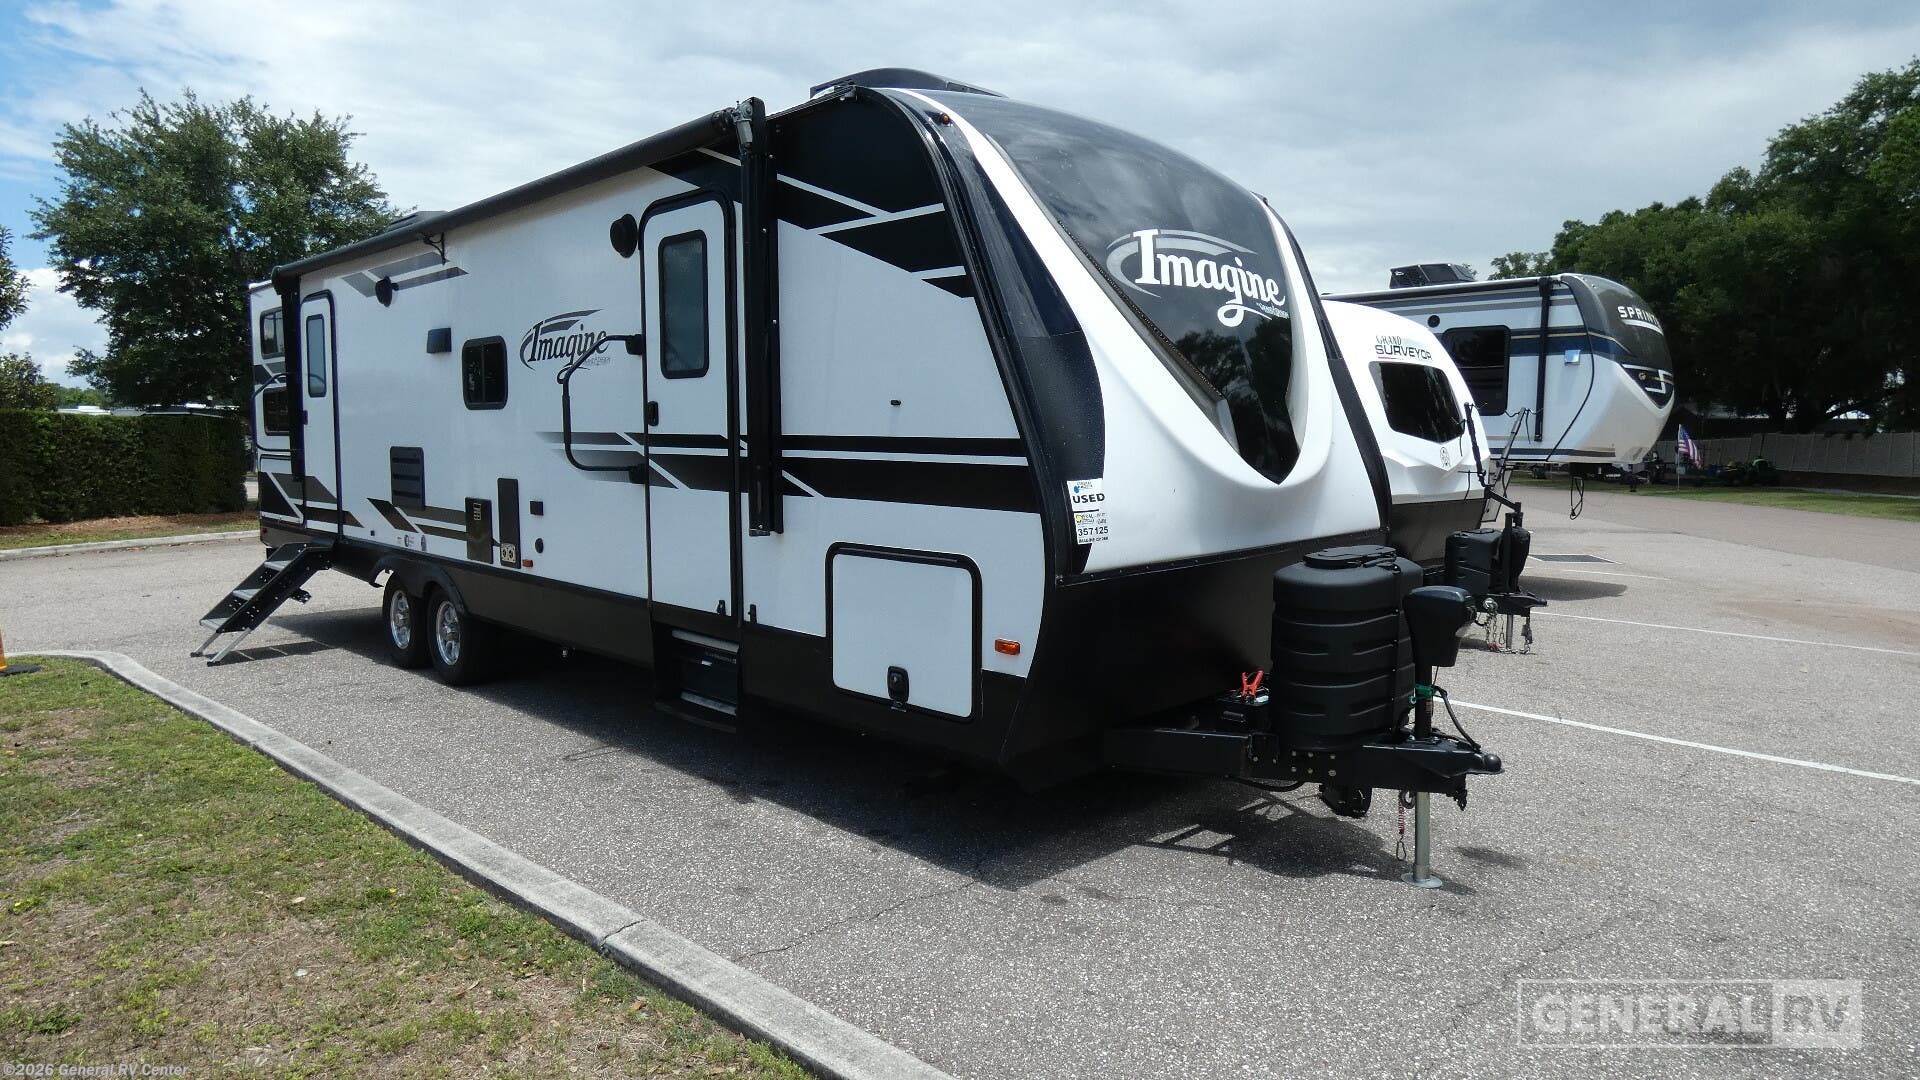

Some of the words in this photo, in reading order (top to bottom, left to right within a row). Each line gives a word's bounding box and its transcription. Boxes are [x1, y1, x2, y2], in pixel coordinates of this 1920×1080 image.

[1132, 229, 1286, 327] Imagine
[527, 321, 609, 384] Imagine
[1375, 345, 1433, 360] SURVEYOR
[1072, 493, 1105, 503] USED
[1078, 526, 1108, 536] 357125
